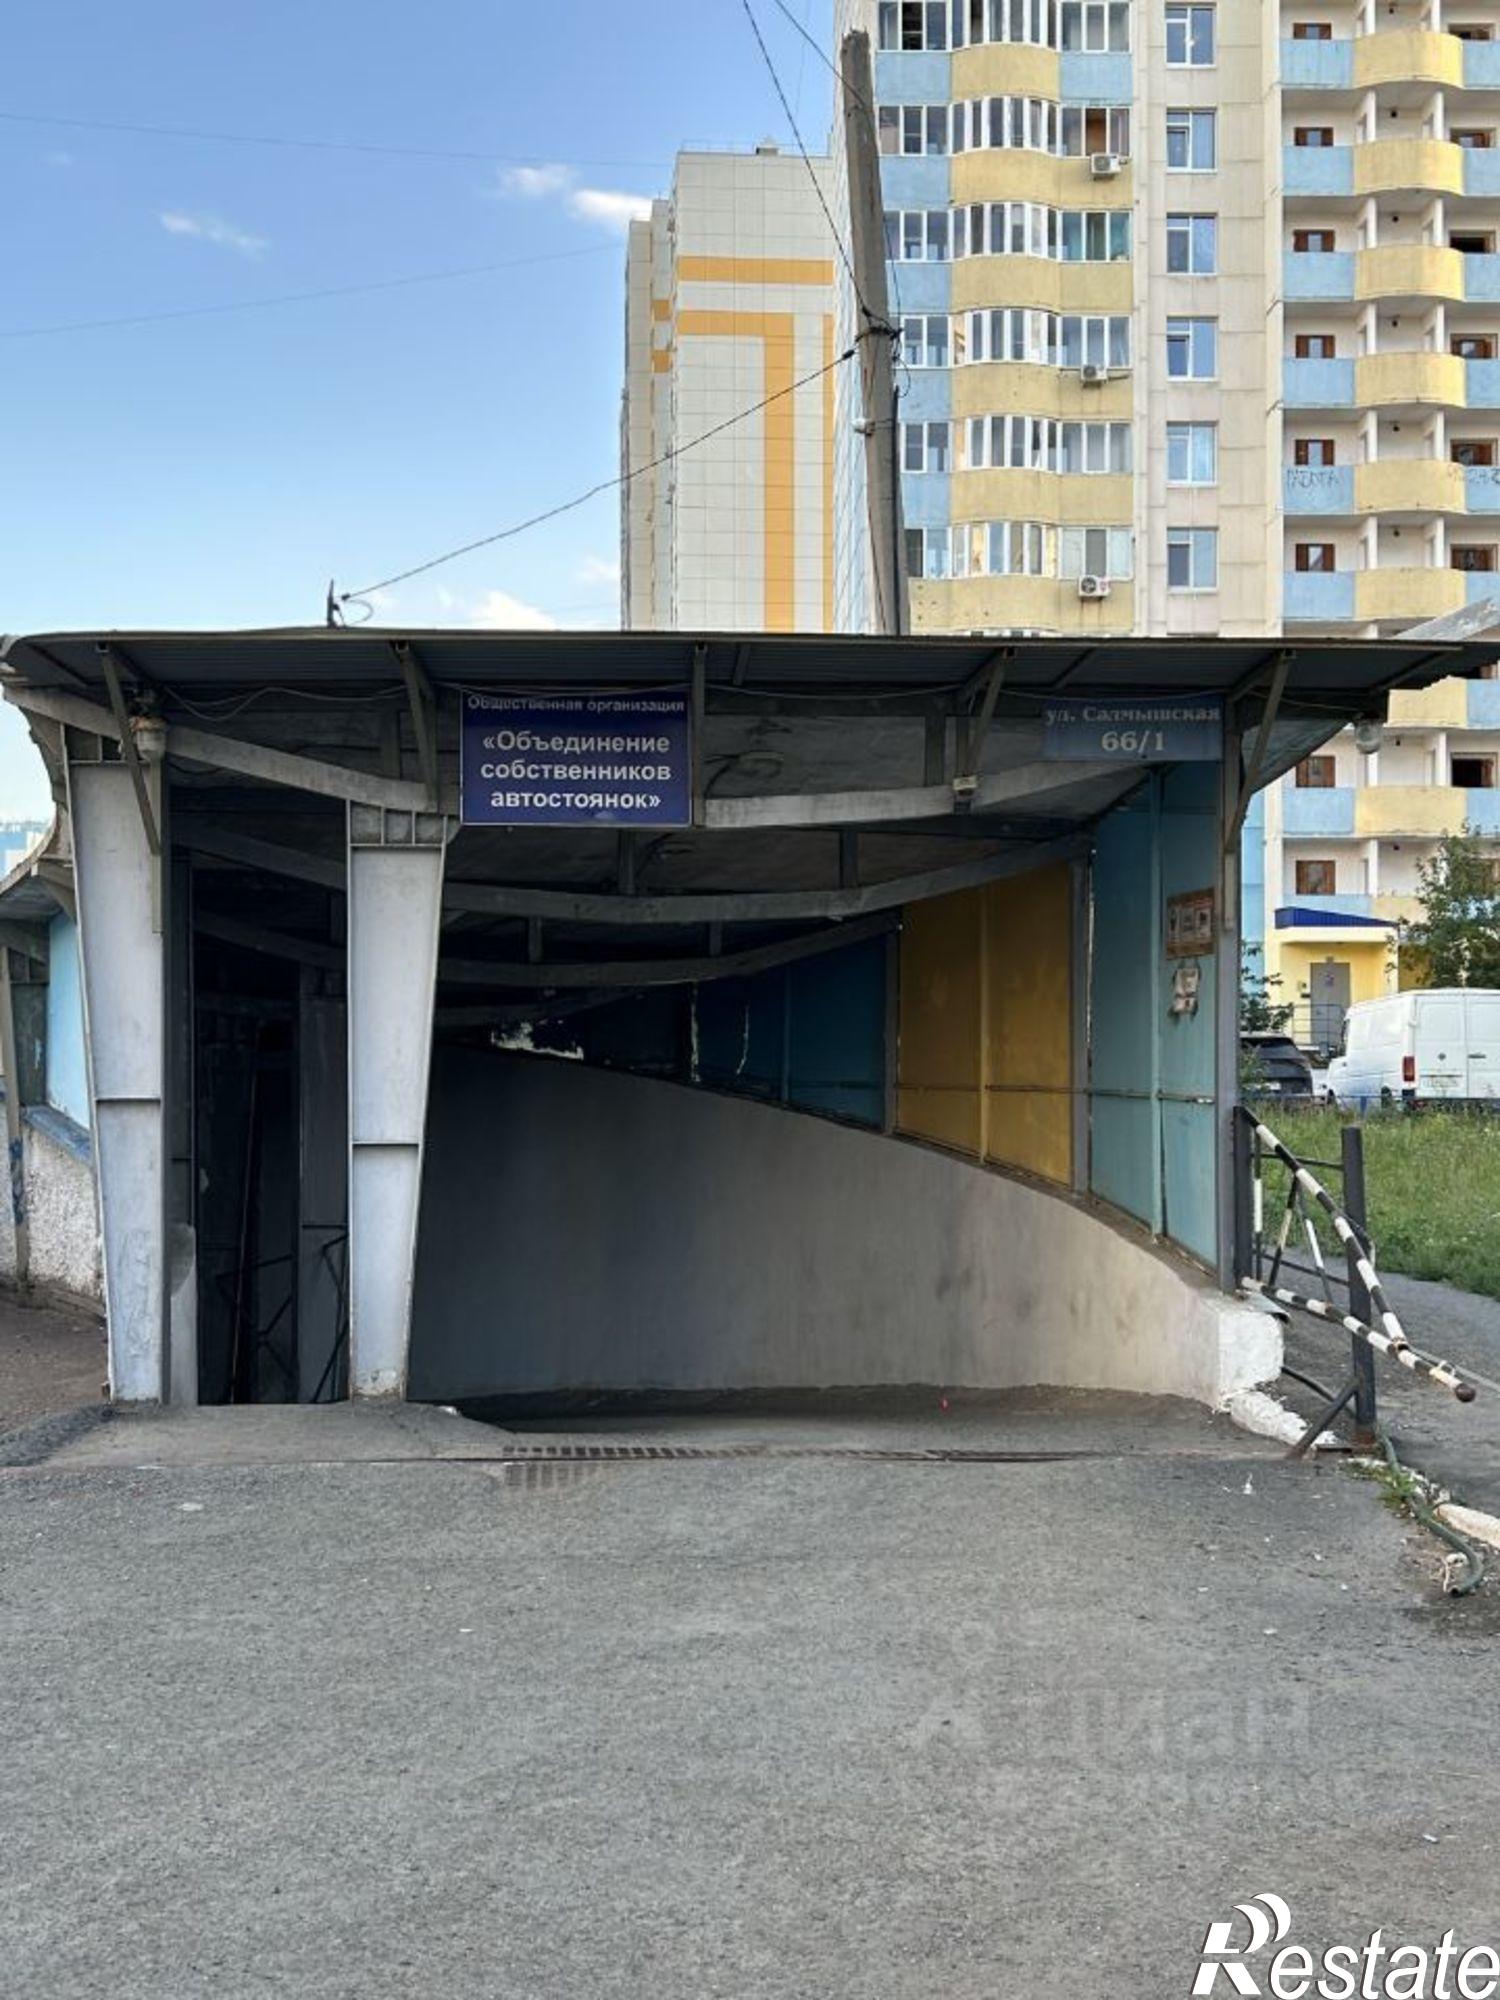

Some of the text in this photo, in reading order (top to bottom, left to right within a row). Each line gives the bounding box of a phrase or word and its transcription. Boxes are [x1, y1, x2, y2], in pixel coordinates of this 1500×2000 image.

[467, 695, 685, 714] Общественная организация
[483, 730, 671, 754] «Объединение
[1101, 731, 1165, 754] 66/1
[480, 760, 671, 780] собственников
[490, 790, 662, 809] автостоянок»
